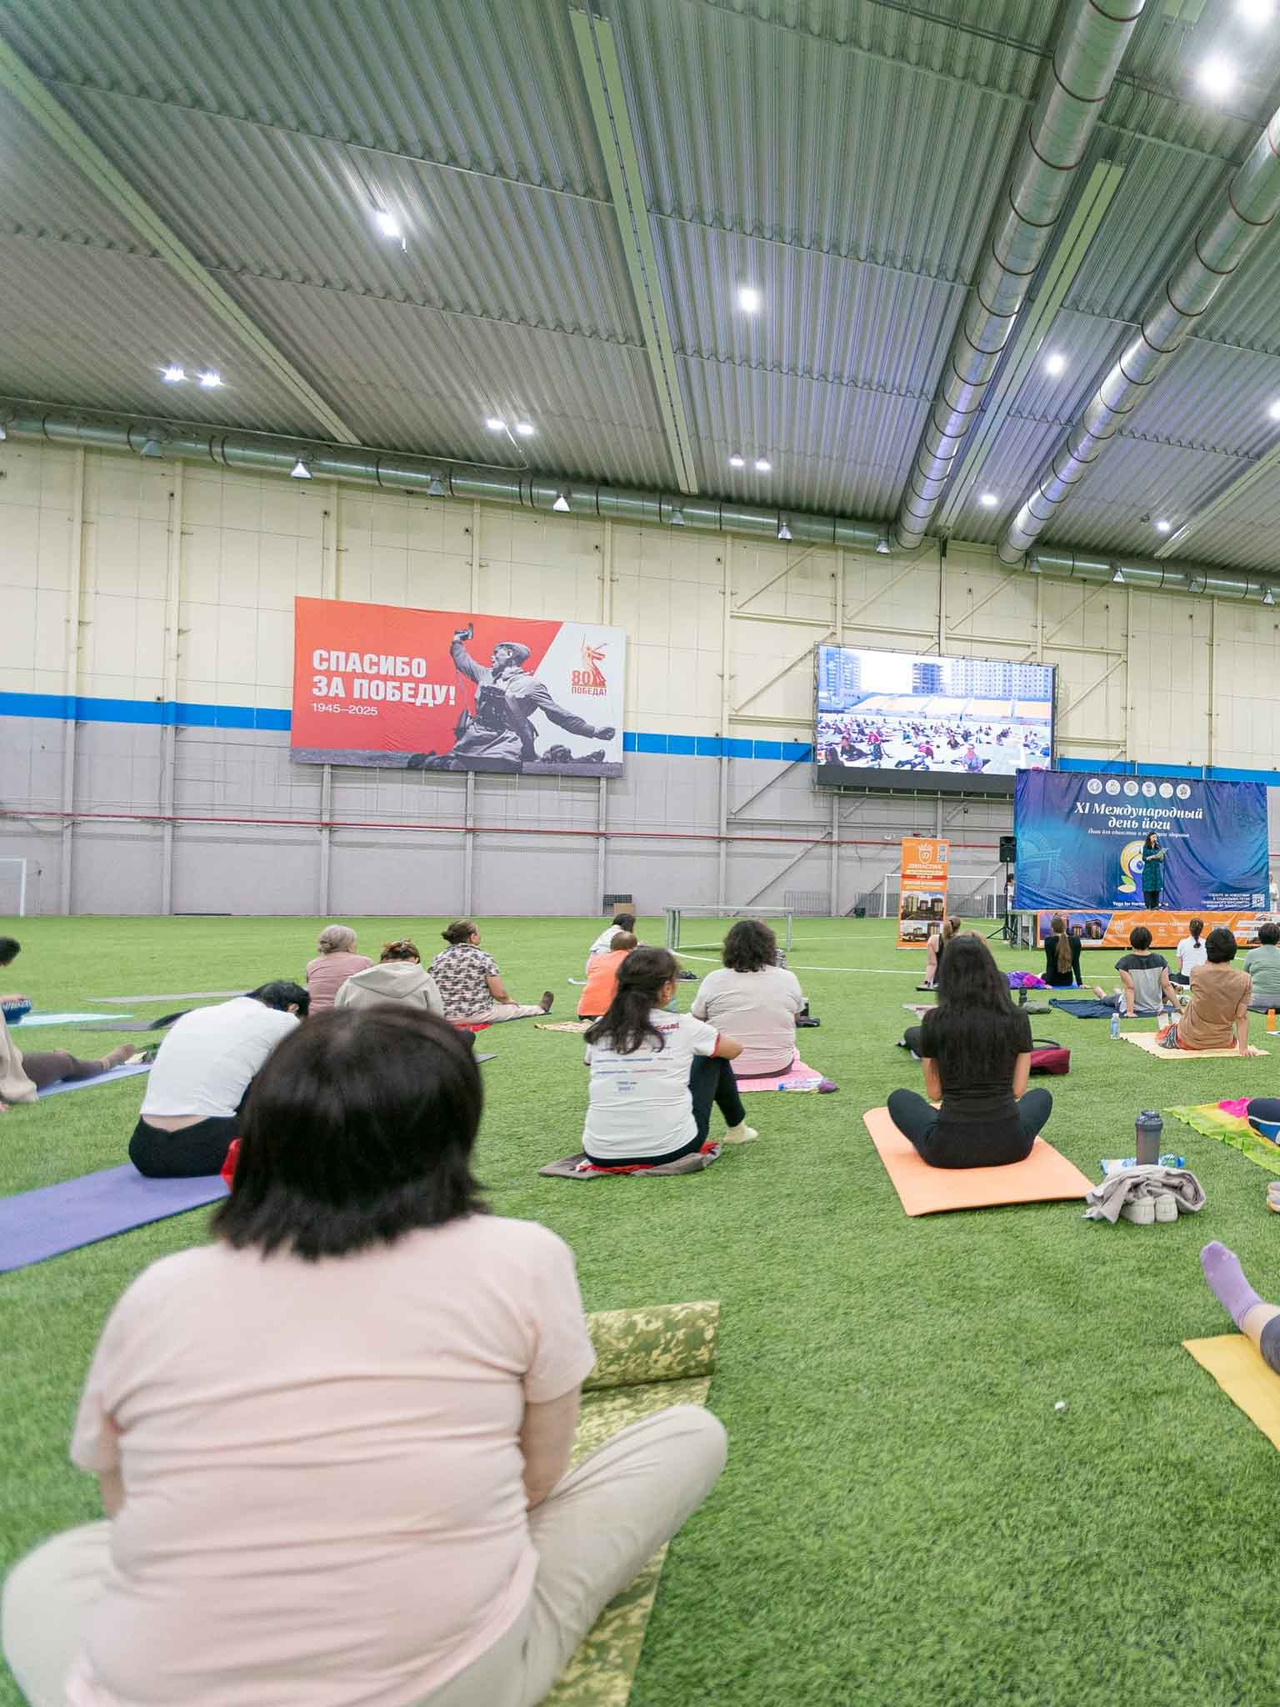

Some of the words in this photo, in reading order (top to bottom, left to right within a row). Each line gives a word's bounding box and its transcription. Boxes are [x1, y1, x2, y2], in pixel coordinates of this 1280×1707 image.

[312, 649, 427, 678] СПАСИБО
[571, 669, 591, 686] 80
[312, 676, 345, 698] ЗА
[353, 679, 457, 707] ПОБЕДУ!
[571, 686, 607, 697] ПОБЕДА!
[1074, 801, 1090, 814] XI
[1092, 802, 1204, 820] Международный
[1108, 816, 1139, 829] день
[1141, 817, 1171, 830] йоги
